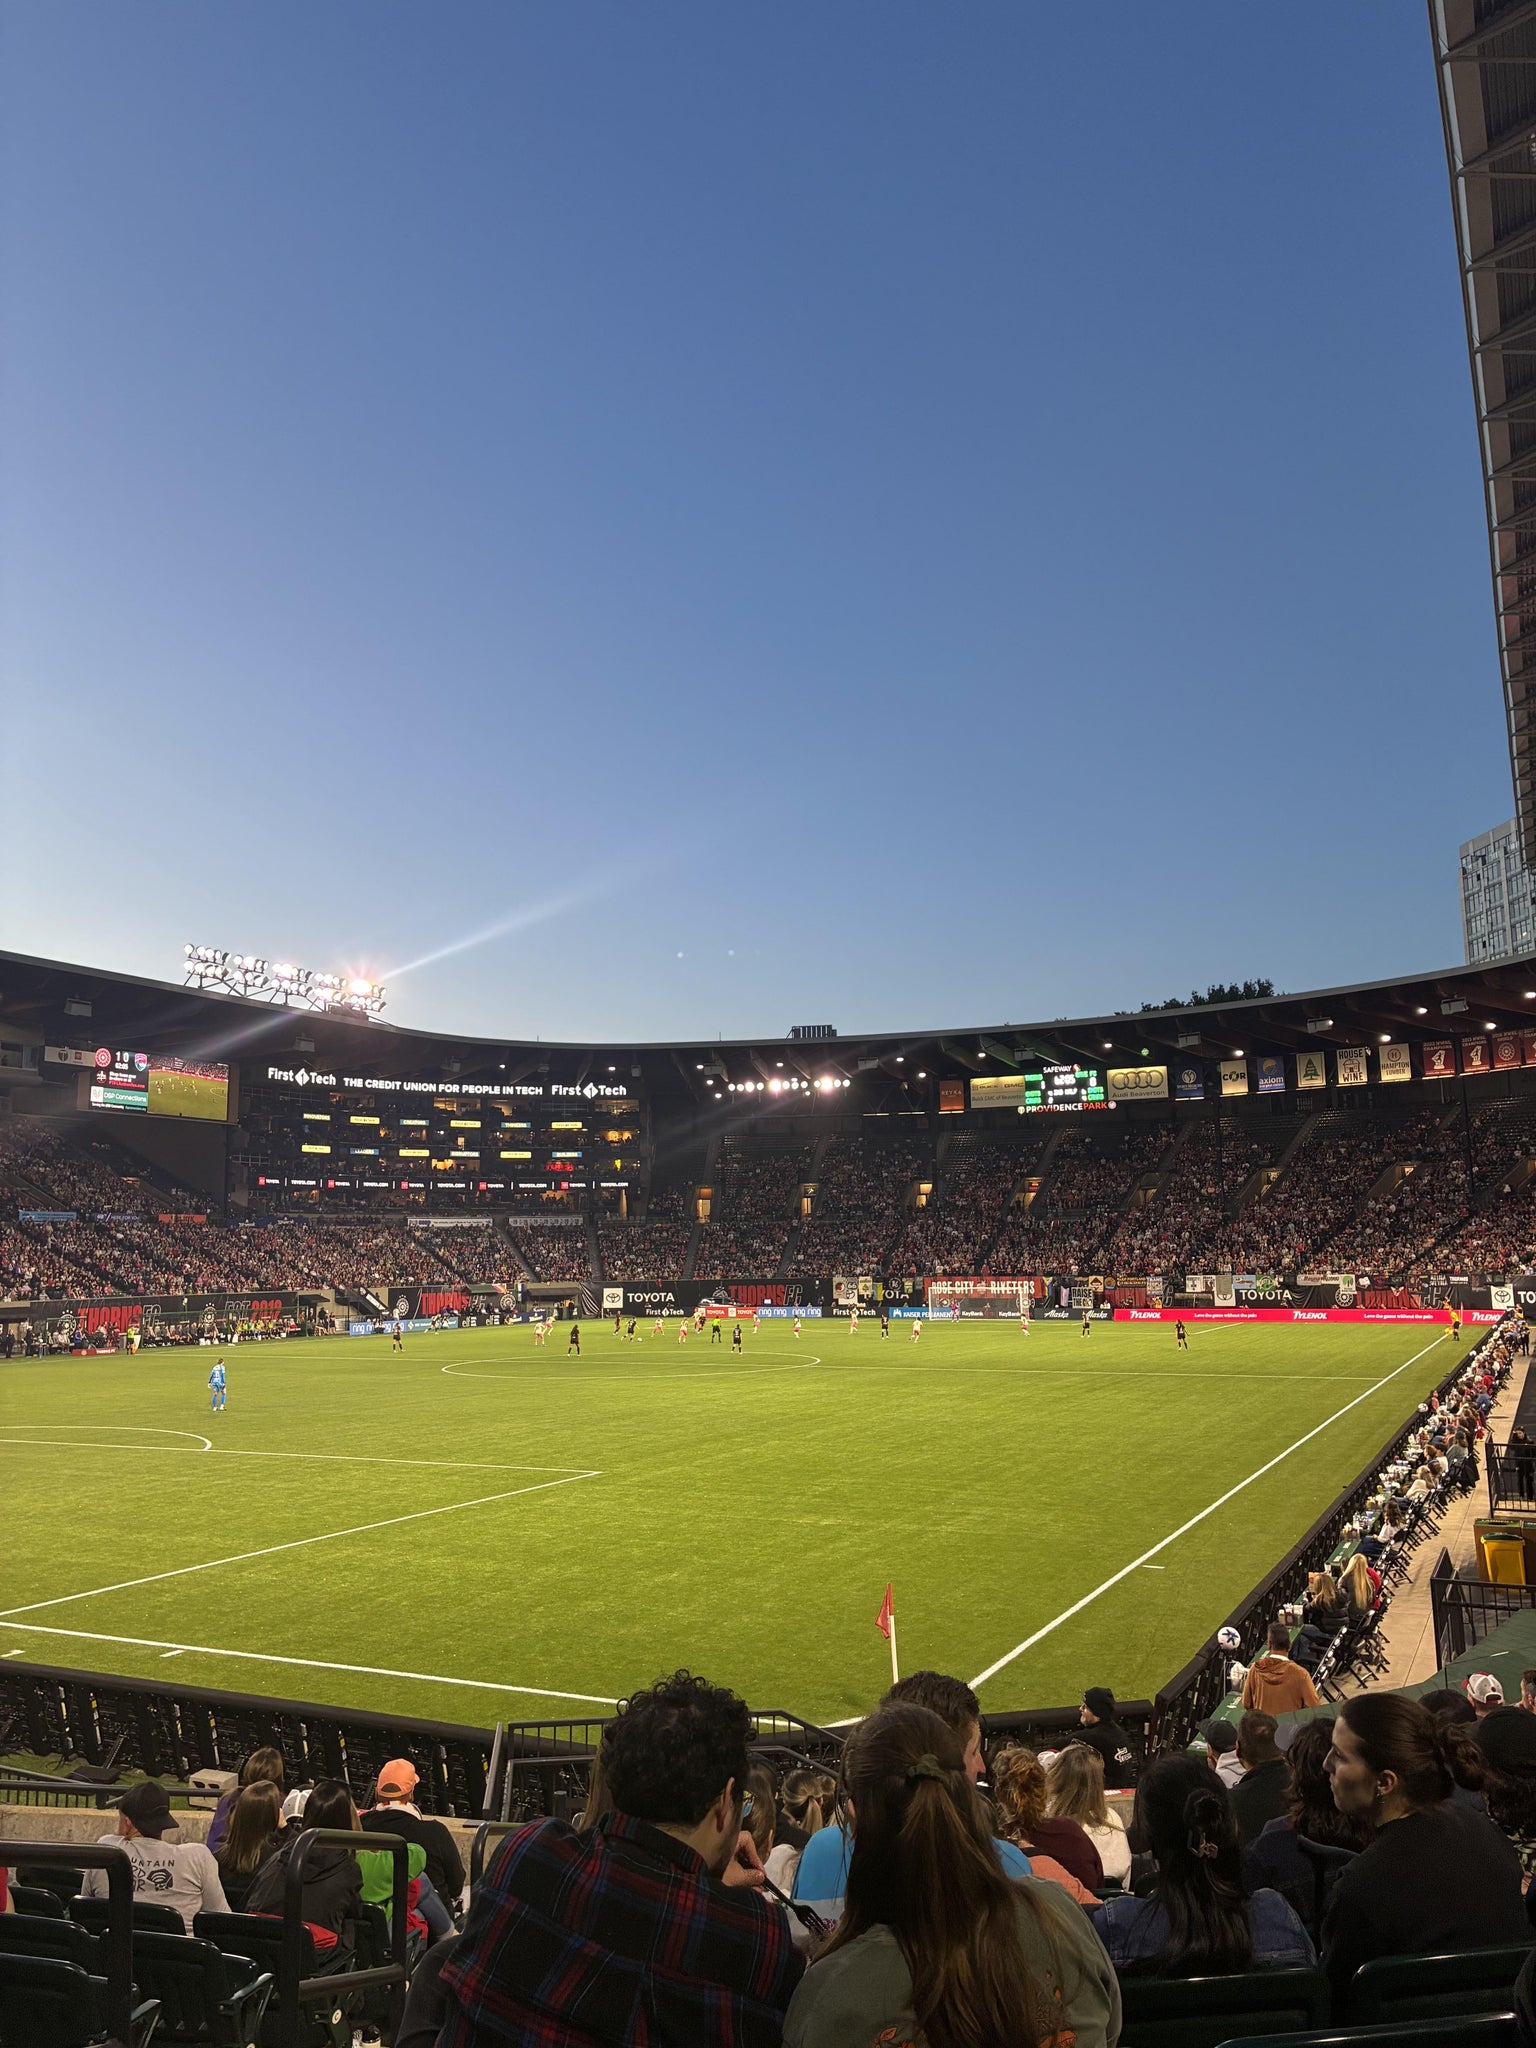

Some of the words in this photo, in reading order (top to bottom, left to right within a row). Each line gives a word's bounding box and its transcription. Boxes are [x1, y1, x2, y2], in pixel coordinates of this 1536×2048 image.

[116, 1051, 120, 1061] 1
[123, 1051, 129, 1062] 0
[1338, 1050, 1364, 1060] HOUSE
[1043, 1065, 1072, 1074] SAFEWAY
[1382, 1062, 1410, 1070] HAMPTON
[268, 1067, 294, 1081] First
[310, 1072, 336, 1085] Tech
[1342, 1072, 1364, 1082] WINE
[344, 1078, 363, 1088] THE
[365, 1079, 401, 1090] CREDIT
[403, 1082, 436, 1092] UNION
[438, 1084, 460, 1093] FOR
[462, 1085, 500, 1095] PEOPLE
[502, 1085, 513, 1094] IN
[515, 1086, 543, 1096] TECH
[552, 1085, 581, 1096] First
[598, 1085, 627, 1096] Tech
[1026, 1103, 1083, 1113] PROVIDENCE
[1083, 1101, 1107, 1110] PARK
[932, 1281, 952, 1294] ROSE
[955, 1281, 974, 1294] CITY
[991, 1281, 1035, 1294] RIVETERS
[1072, 1288, 1092, 1298] RAISE
[627, 1293, 675, 1302] TOYOTA
[728, 1285, 785, 1305] THORNS
[784, 1285, 803, 1305] FC
[1240, 1290, 1292, 1300] TOYOTA
[1518, 1291, 1536, 1303] TO
[421, 1292, 469, 1315] THORNS
[1044, 1310, 1068, 1318] Alaska
[1293, 1311, 1327, 1319] TYLENOL
[353, 1323, 365, 1335] ring
